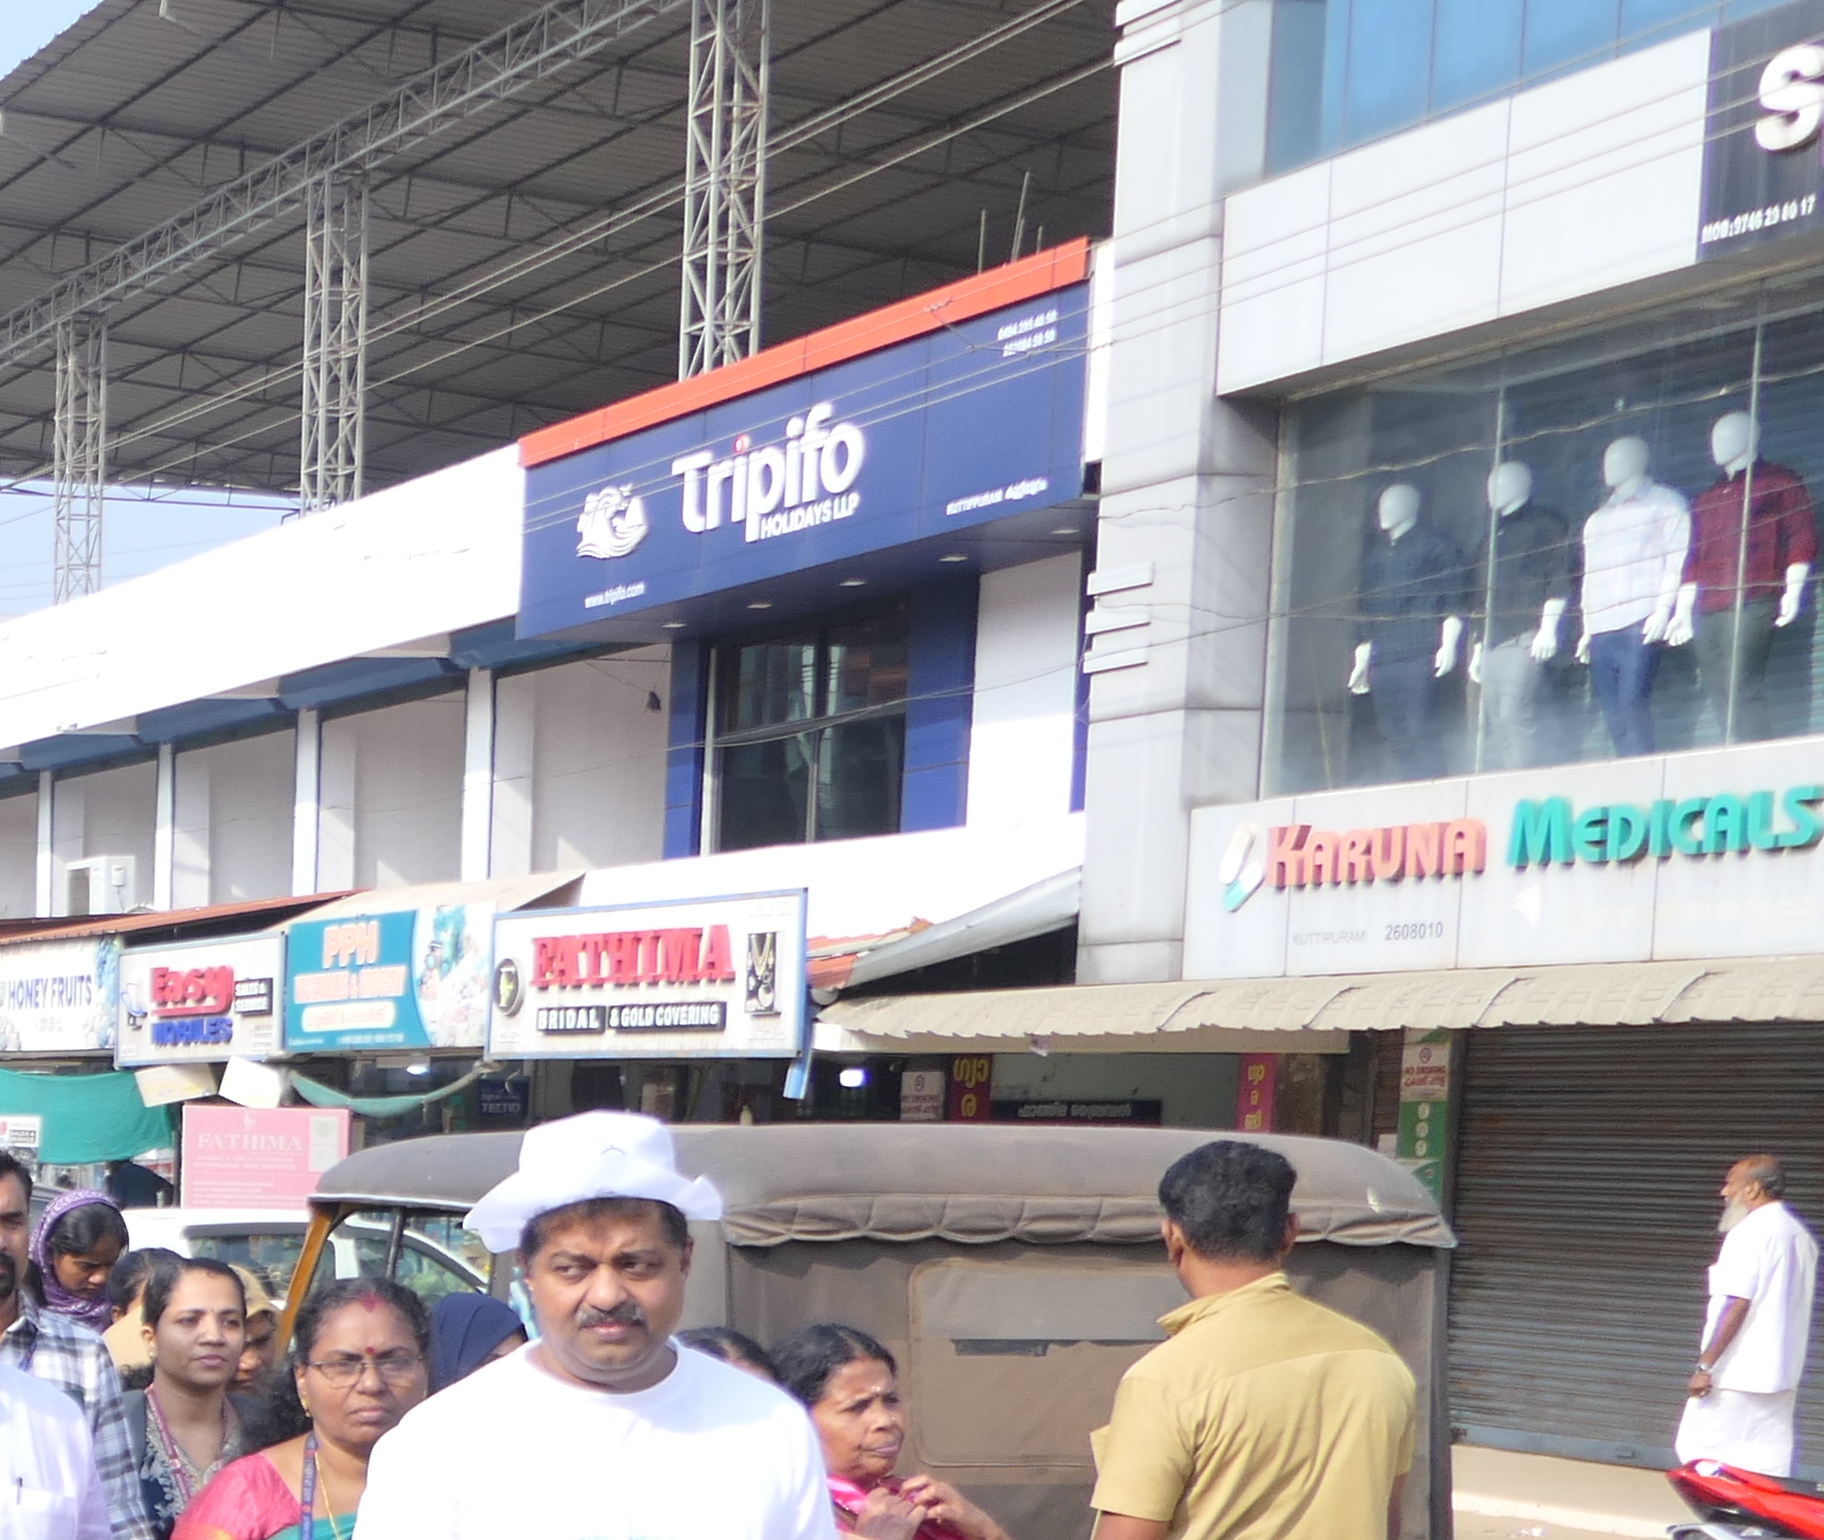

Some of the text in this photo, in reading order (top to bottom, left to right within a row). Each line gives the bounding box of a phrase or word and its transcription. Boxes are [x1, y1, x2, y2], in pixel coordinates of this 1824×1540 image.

[672, 402, 866, 542] Tripifo
[760, 492, 860, 539] HOLIDAYS LLP
[1268, 786, 1824, 888] KARUNA MEDICALS
[323, 920, 378, 969] PPH
[530, 925, 736, 989] FATHIMA
[1293, 922, 1444, 947] KUTTIPURAM 2608010
[8, 975, 92, 1010] HONEY FRUITS
[150, 965, 234, 1017] Easy
[538, 1004, 719, 1030] BRIDAL & GOLD COVERING
[198, 1133, 302, 1151] FATHIMA
